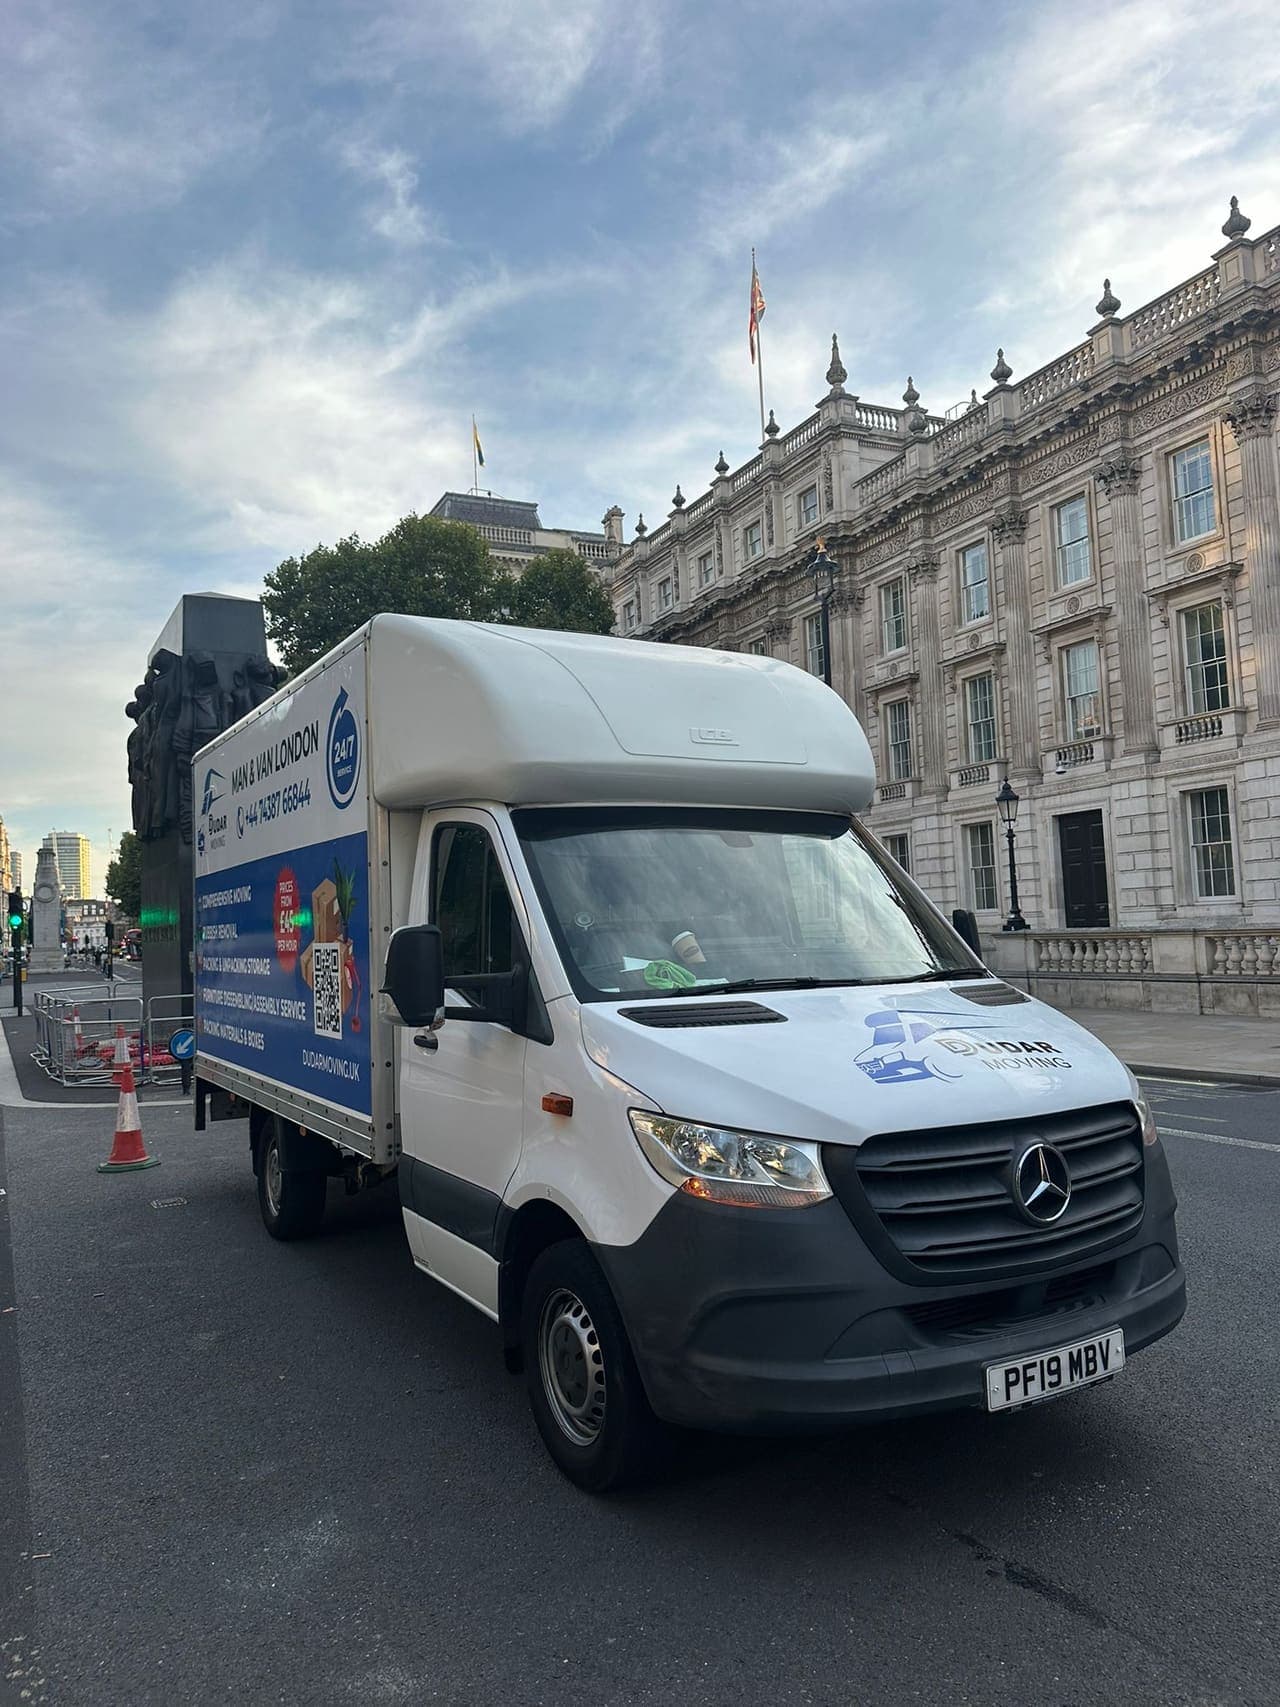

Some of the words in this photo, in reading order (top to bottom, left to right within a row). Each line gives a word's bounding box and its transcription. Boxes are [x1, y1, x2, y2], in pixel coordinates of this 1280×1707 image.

[232, 762, 248, 796] MAN
[249, 759, 255, 786] &
[256, 746, 274, 781] VAN
[275, 720, 319, 772] LONDON
[334, 735, 355, 764] 24/7
[246, 801, 258, 827] +44
[259, 790, 281, 824] 74387
[282, 777, 311, 814] 66844
[208, 814, 228, 836] DUDAR
[233, 885, 251, 905] MOVING
[279, 880, 293, 894] PRICES
[280, 895, 293, 908] FROM
[277, 940, 285, 952] PER
[285, 940, 298, 952] HOUR
[247, 958, 271, 976] STORAGE
[280, 998, 306, 1021] SERVICE
[247, 1030, 265, 1051] BOXES
[934, 1037, 1063, 1057] DUDAR
[302, 1048, 361, 1082] DUDARMOVING.UK
[981, 1056, 1073, 1071] MOVING
[1004, 1354, 1062, 1401] PF19
[1068, 1338, 1111, 1382] MBV
